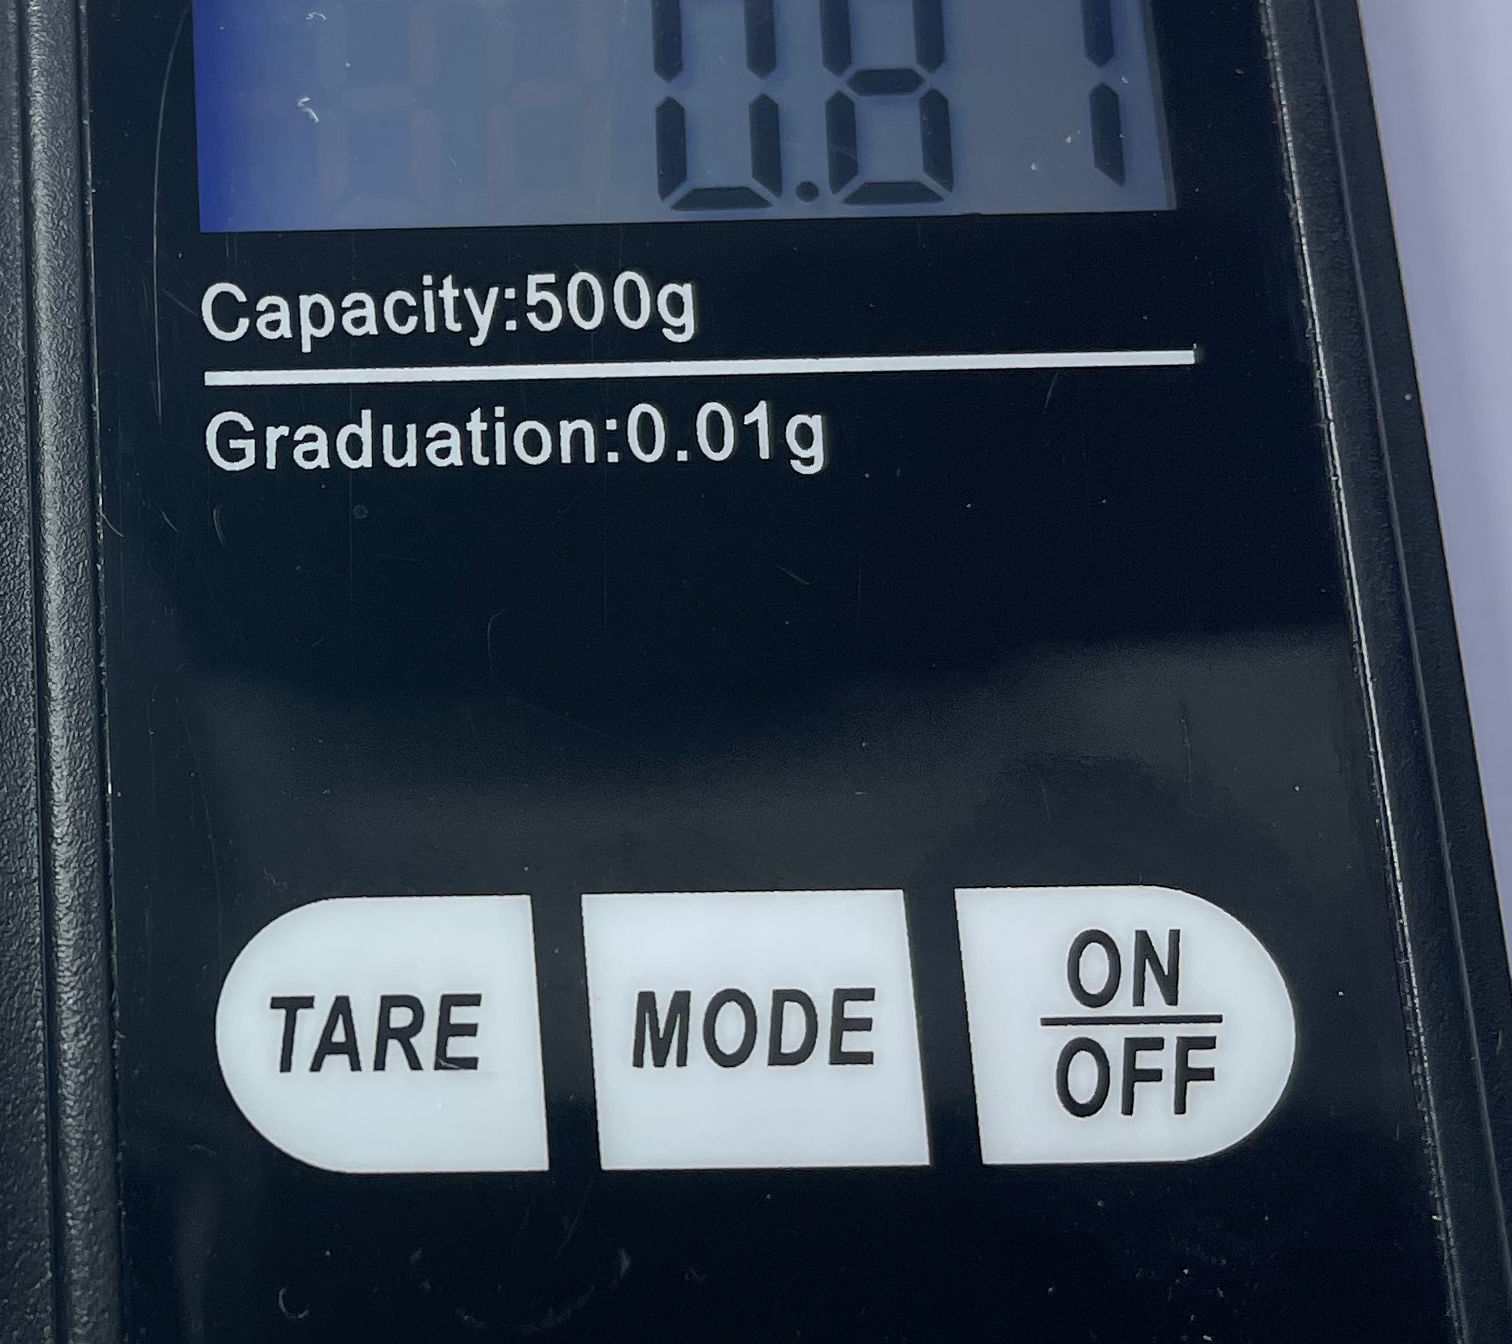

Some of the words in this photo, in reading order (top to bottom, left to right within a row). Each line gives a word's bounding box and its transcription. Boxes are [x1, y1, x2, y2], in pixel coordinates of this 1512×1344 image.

[200, 270, 697, 353] Capacity:500g
[204, 400, 826, 475] Graduation:0.01g
[1064, 927, 1182, 1010] ON
[269, 993, 483, 1074] TARE
[631, 987, 877, 1070] MODE
[1054, 1035, 1218, 1118] OFF
